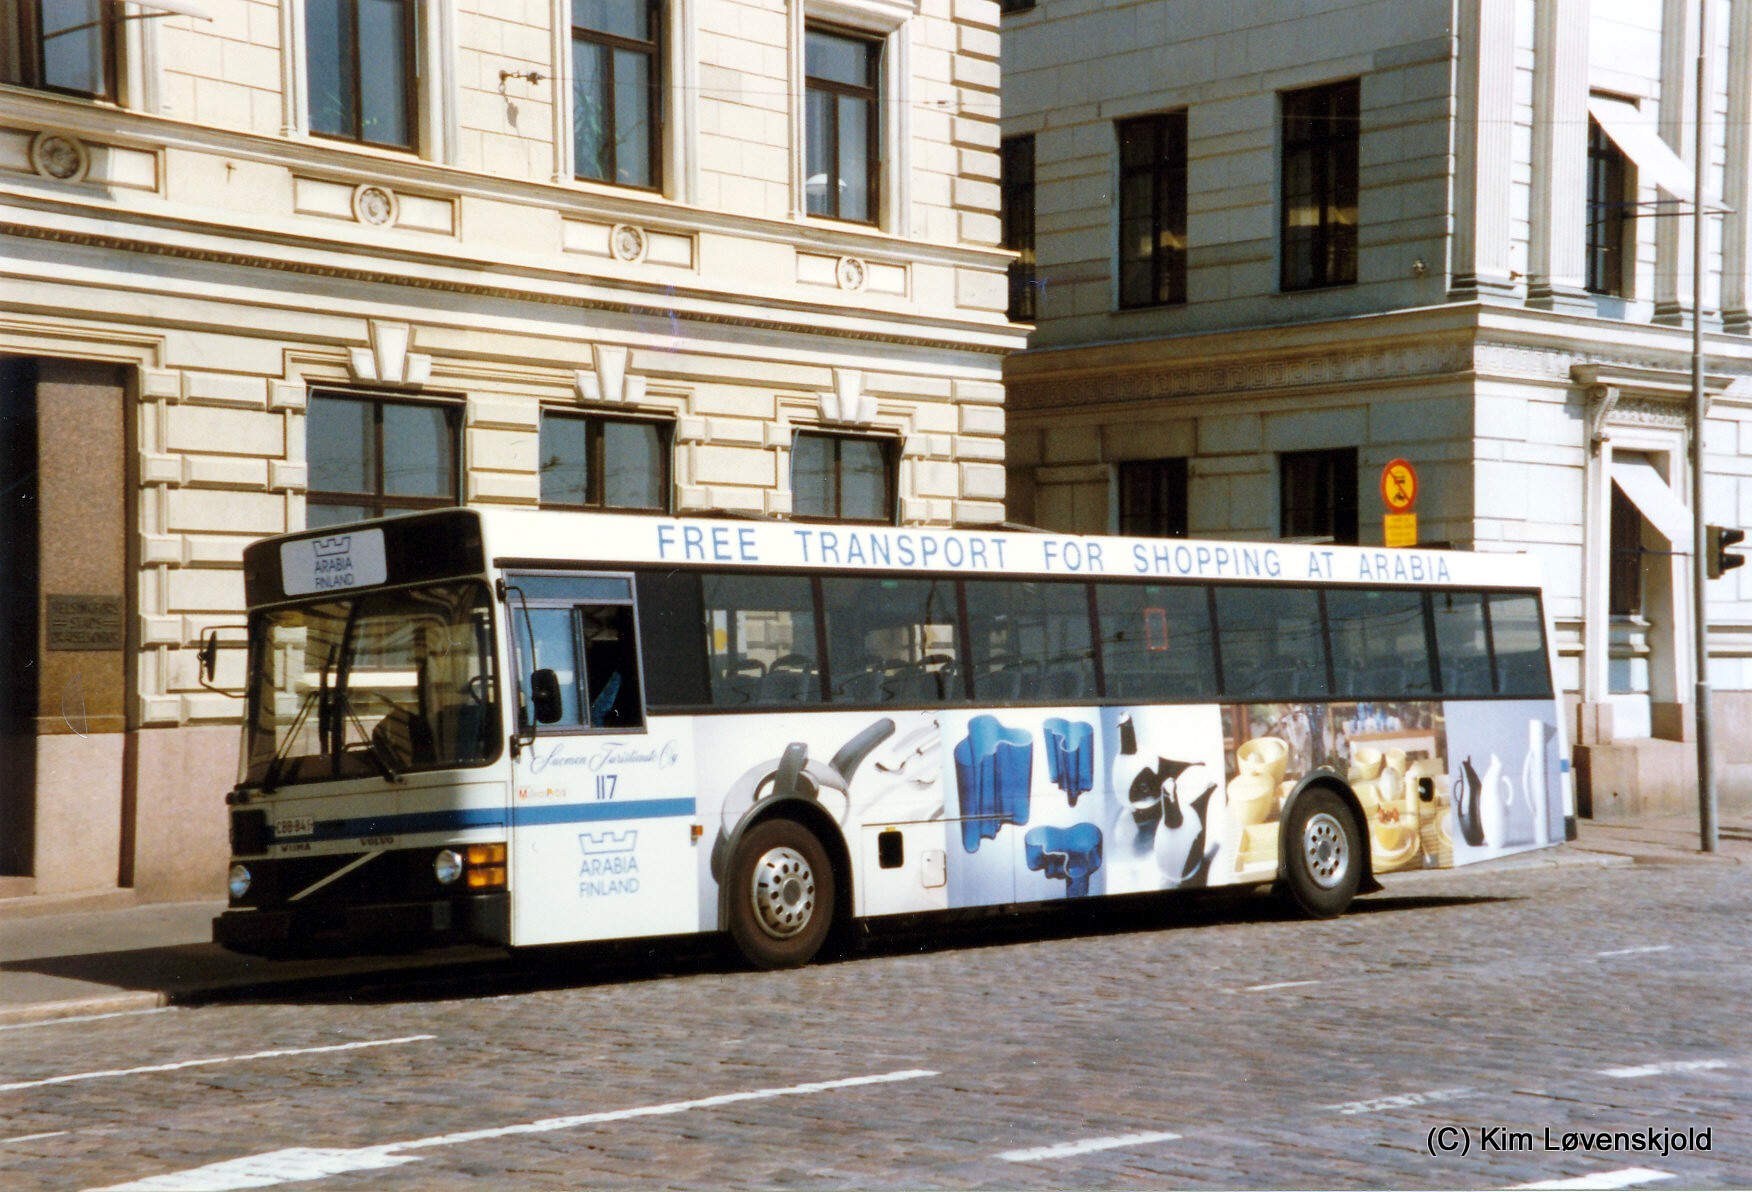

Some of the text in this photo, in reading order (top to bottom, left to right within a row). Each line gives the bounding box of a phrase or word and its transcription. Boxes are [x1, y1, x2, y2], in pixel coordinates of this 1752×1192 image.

[657, 525, 1451, 582] FREE TRANSPORT FOR SHOPPING AT ARABIA
[314, 558, 353, 575] ARABIA
[314, 573, 354, 590] FINLAND
[596, 774, 618, 799] 117
[360, 836, 394, 847] VOLVO
[579, 856, 639, 877] ARABIA
[580, 877, 640, 898] FINLAND
